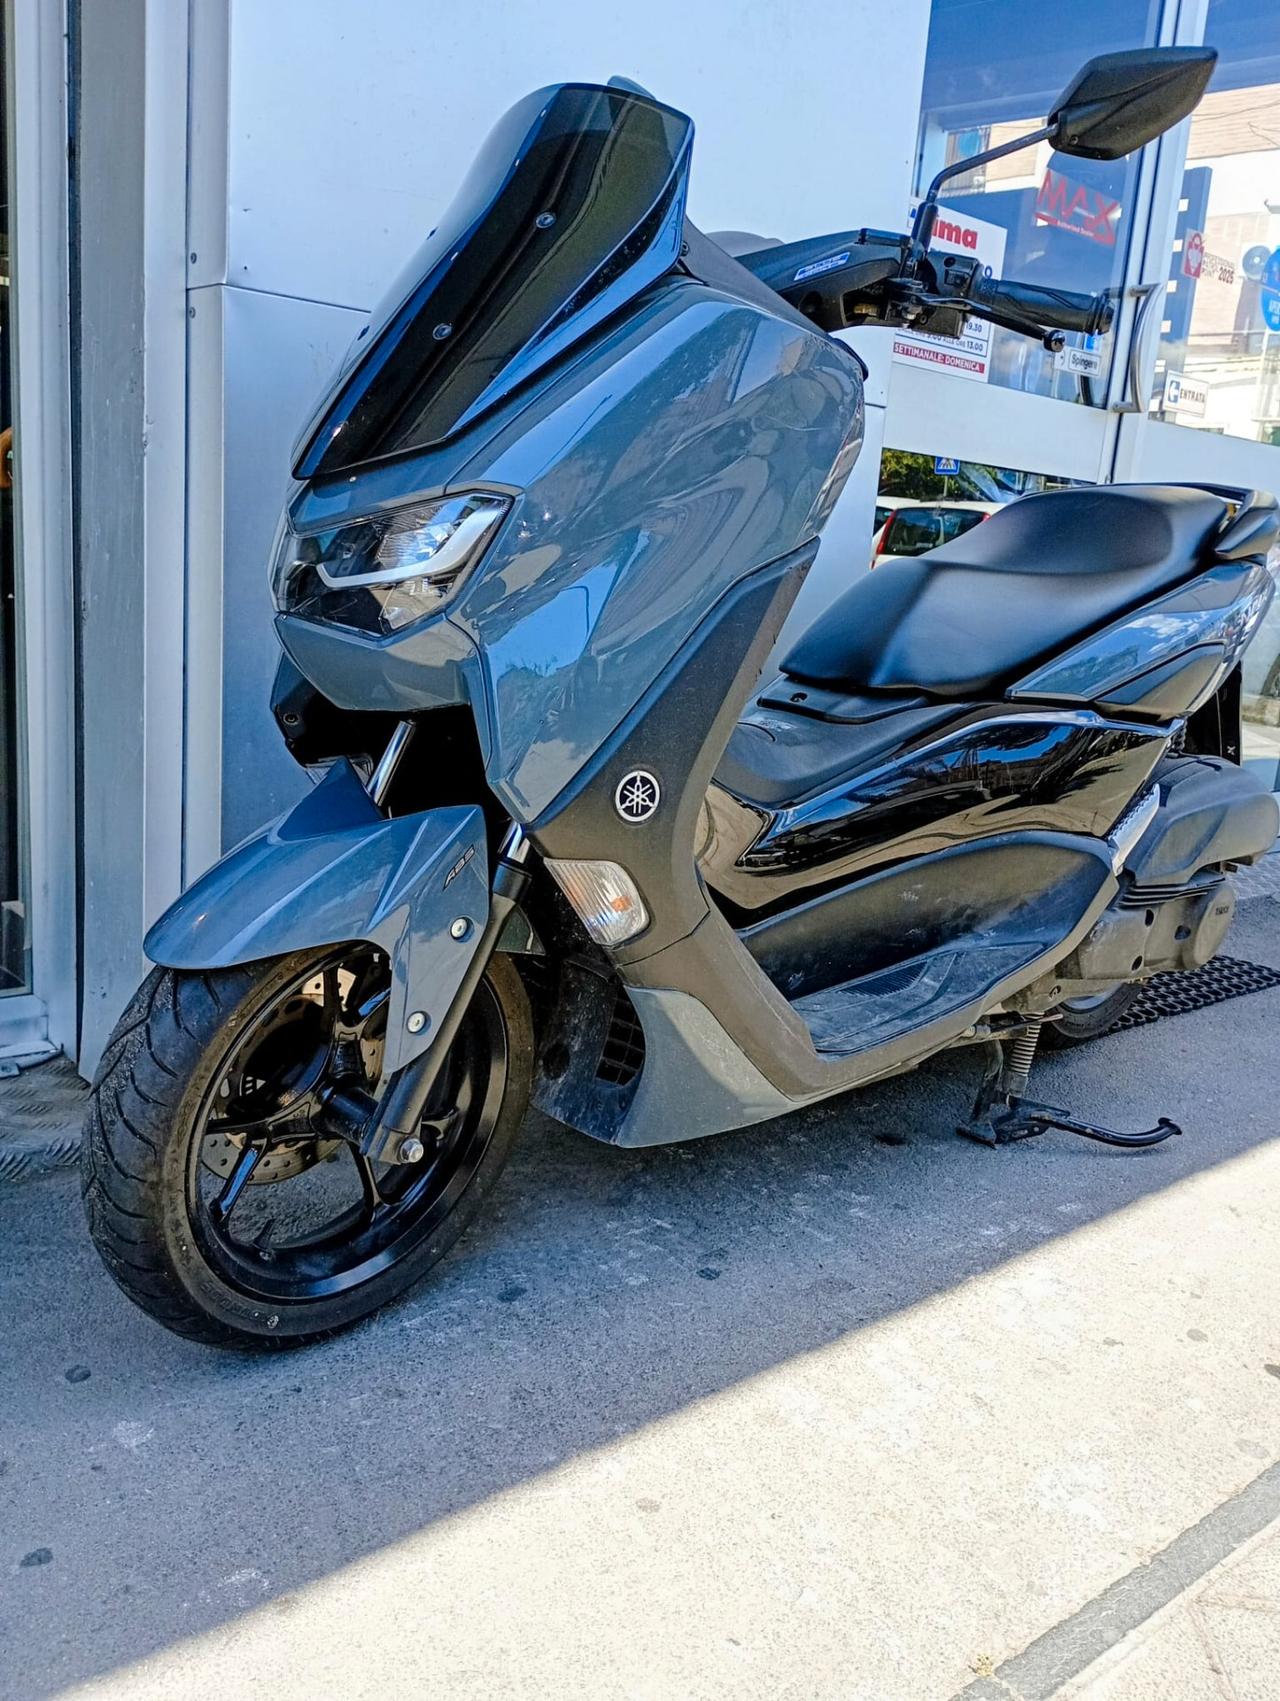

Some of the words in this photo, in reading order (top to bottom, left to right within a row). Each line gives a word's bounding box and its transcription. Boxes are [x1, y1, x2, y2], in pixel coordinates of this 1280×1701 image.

[1036, 168, 1119, 246] MAX
[894, 343, 944, 362] SETTIMANALE:
[945, 355, 980, 372] DOMENICA
[966, 341, 984, 353] 13.00
[1179, 388, 1205, 404] ENTRATA
